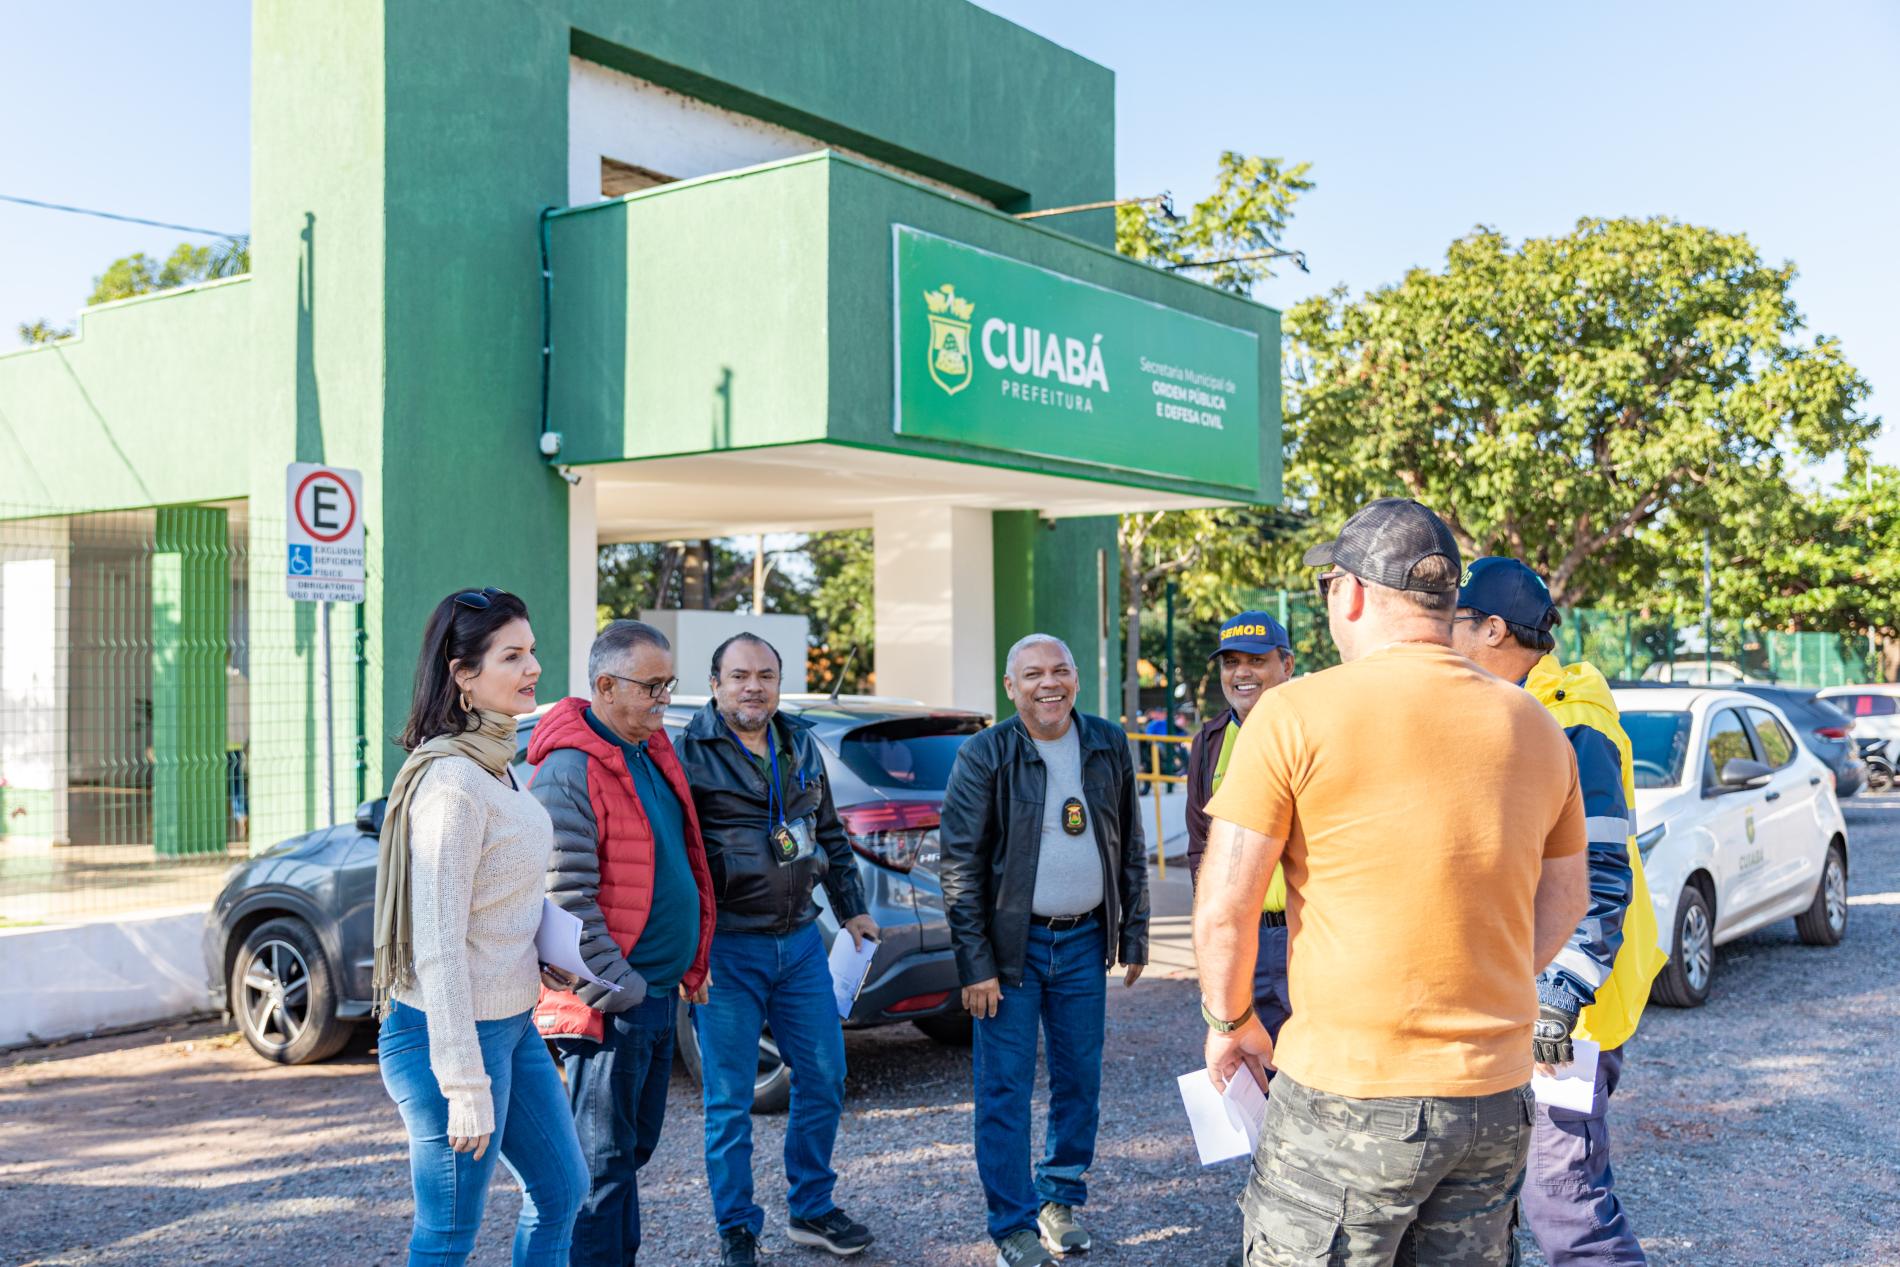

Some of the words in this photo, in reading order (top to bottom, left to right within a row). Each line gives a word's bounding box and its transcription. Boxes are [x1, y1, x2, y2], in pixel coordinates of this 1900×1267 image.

[981, 317, 1109, 392] CUIABÁ
[1140, 356, 1183, 381] Secretaria
[1185, 368, 1224, 391] Municipal
[1225, 380, 1236, 394] de
[1002, 379, 1093, 414] PREFEITURA
[1152, 381, 1187, 402] ORDEM
[1188, 388, 1226, 411] PÚBLICA
[1156, 401, 1163, 417] E
[1164, 403, 1200, 425] DEFESA
[1200, 411, 1224, 430] CIVIL
[314, 485, 339, 530] E
[315, 545, 362, 556] EXCLUSIVO
[315, 556, 363, 567] DEFICIENTE
[291, 591, 308, 600] USO
[313, 592, 325, 601] DO
[1221, 624, 1266, 641] SEMOB
